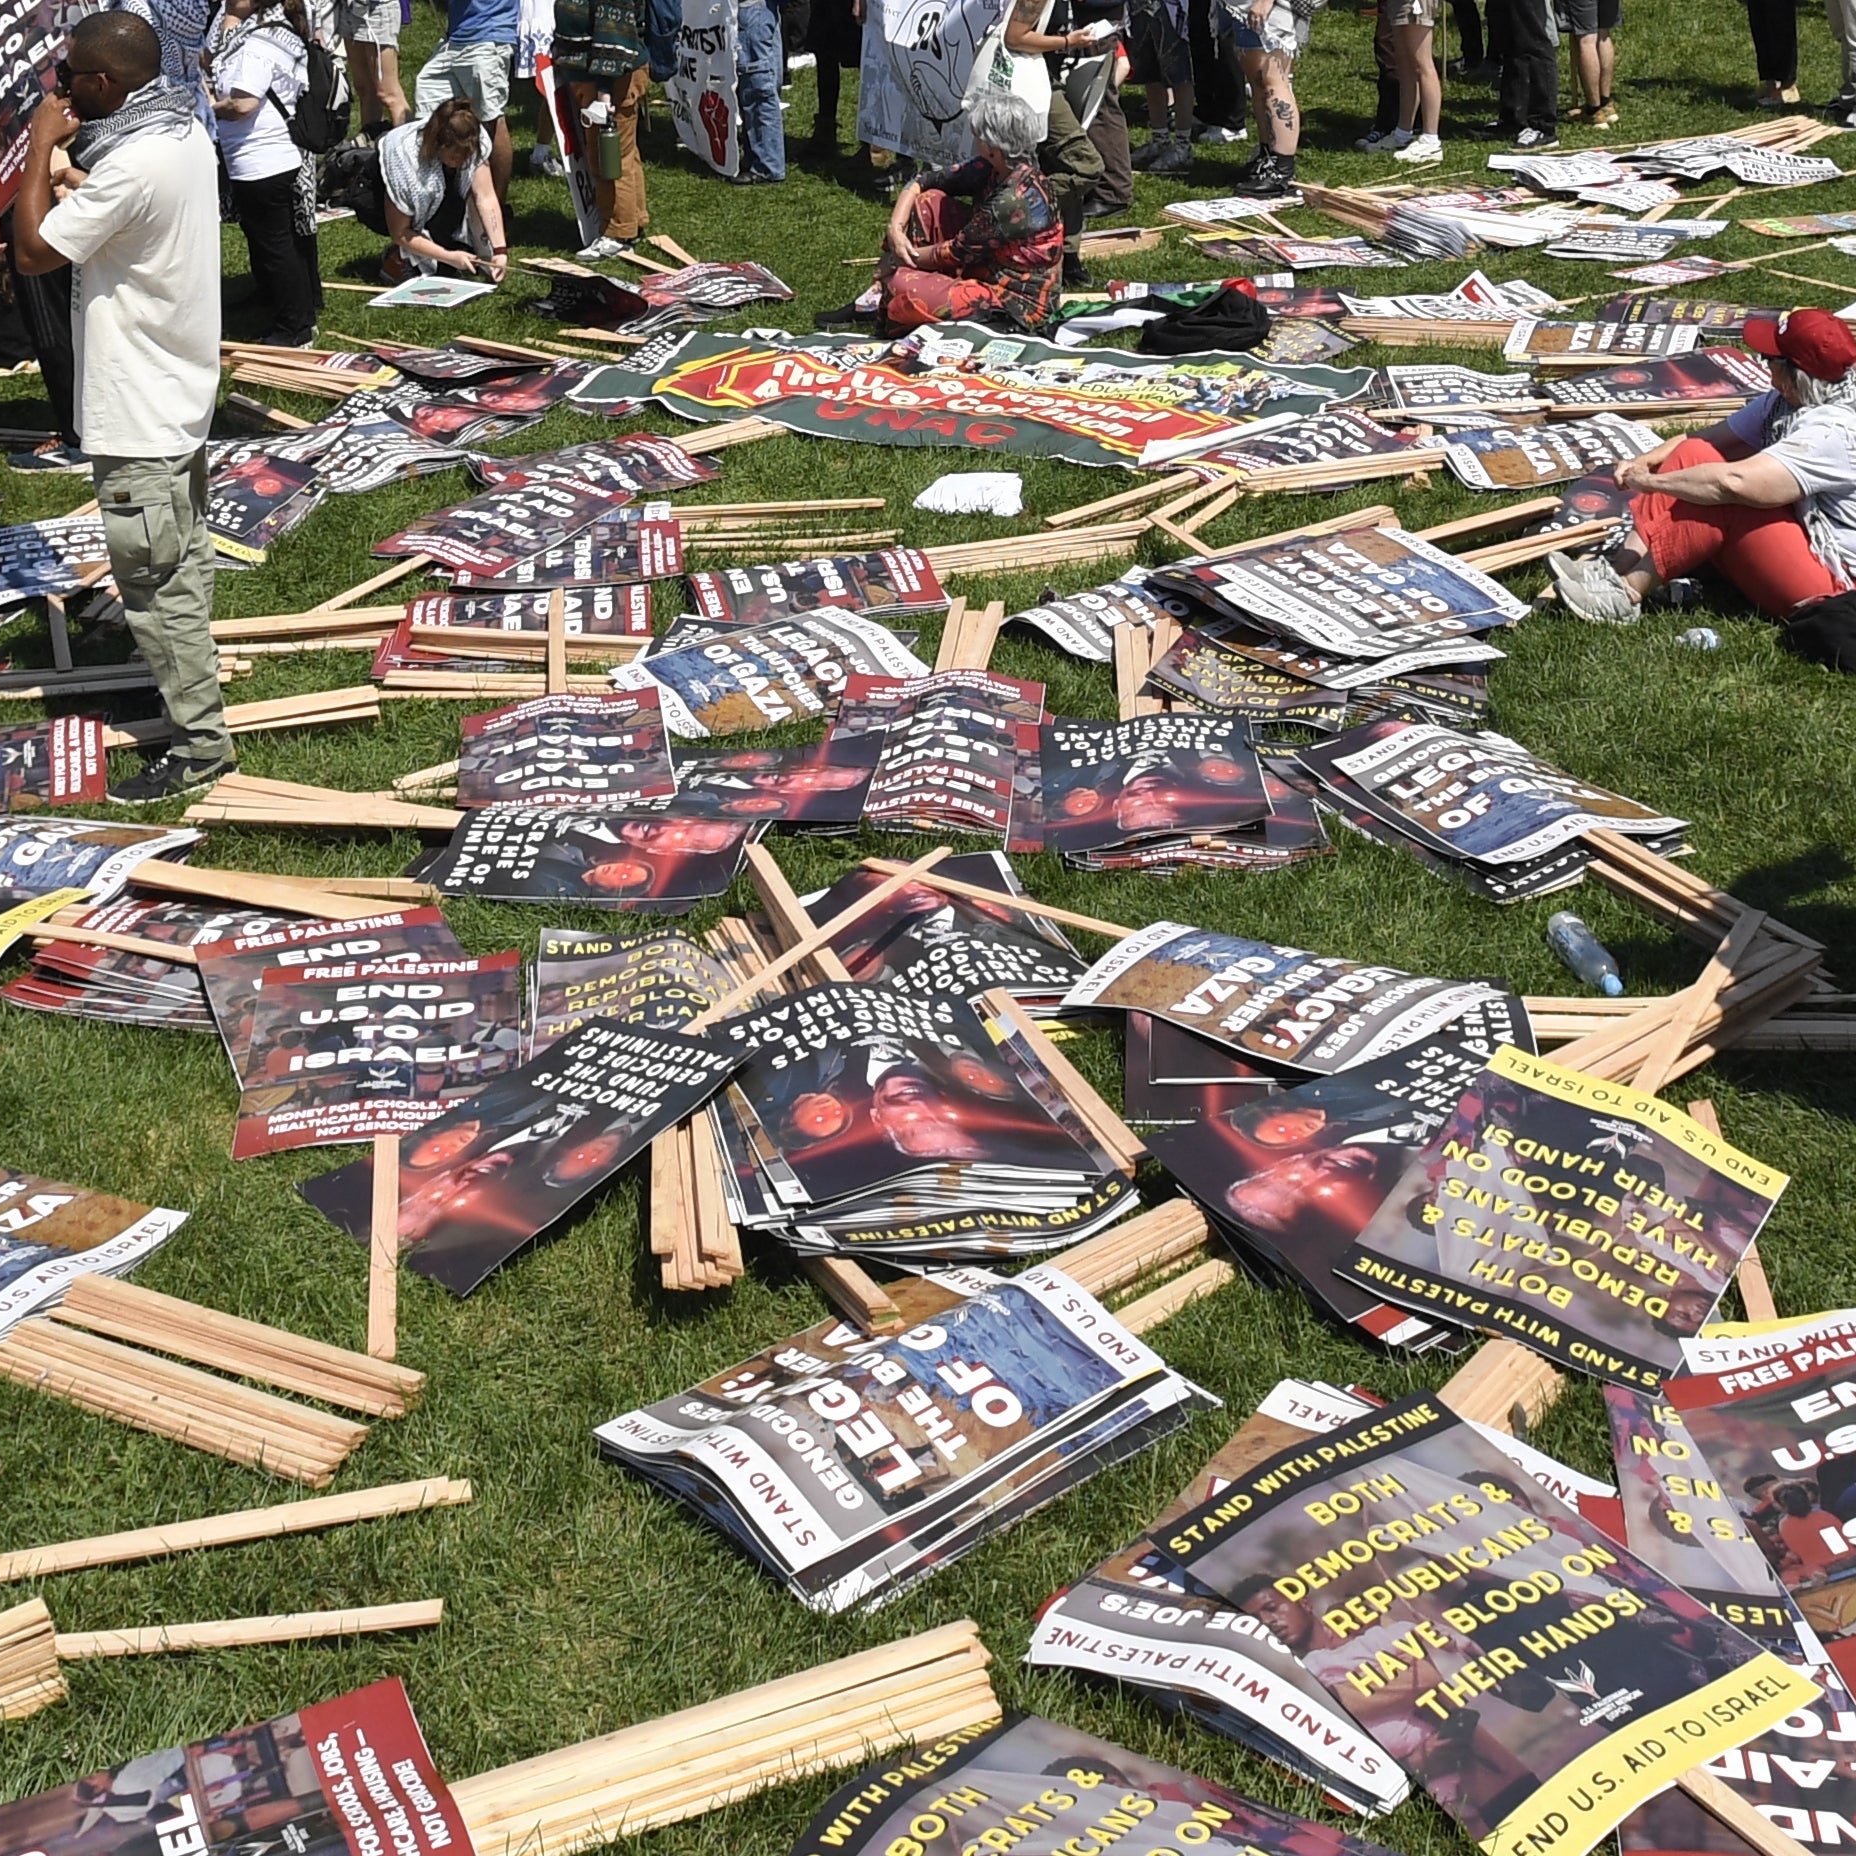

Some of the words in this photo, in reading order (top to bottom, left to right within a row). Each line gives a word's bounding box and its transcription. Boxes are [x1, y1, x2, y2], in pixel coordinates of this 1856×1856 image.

[563, 1062, 607, 1082] THE
[564, 1044, 597, 1060] OF
[580, 1027, 735, 1071] PALESTINIANS
[597, 1054, 708, 1086] GENOCIDE
[531, 1073, 662, 1117] DEMOCRATS
[608, 1073, 670, 1098] FUND
[98, 1220, 168, 1261] ISRAEL
[937, 1357, 1024, 1428] OF
[1719, 1360, 1791, 1396] FREE
[1168, 1494, 1253, 1555] STAND
[1257, 1458, 1320, 1498] WITH
[1318, 1404, 1440, 1465] PALESTINE
[1303, 1472, 1408, 1528] BOTH
[1273, 1497, 1474, 1604] DEMOCRATS
[1479, 1481, 1513, 1506] &
[1323, 1517, 1553, 1640] REPUBLICANS
[1345, 1619, 1449, 1698] HAVE
[1440, 1568, 1564, 1637] BLOOD
[1560, 1544, 1619, 1581] ON
[1414, 1650, 1525, 1722] THEIR
[1518, 1587, 1648, 1663] HANDS!
[1511, 1810, 1570, 1856] END
[1565, 1769, 1624, 1811] U.S.
[1618, 1738, 1667, 1774] AID
[1663, 1716, 1707, 1747] TO
[1710, 1674, 1792, 1727] ISRAEL
